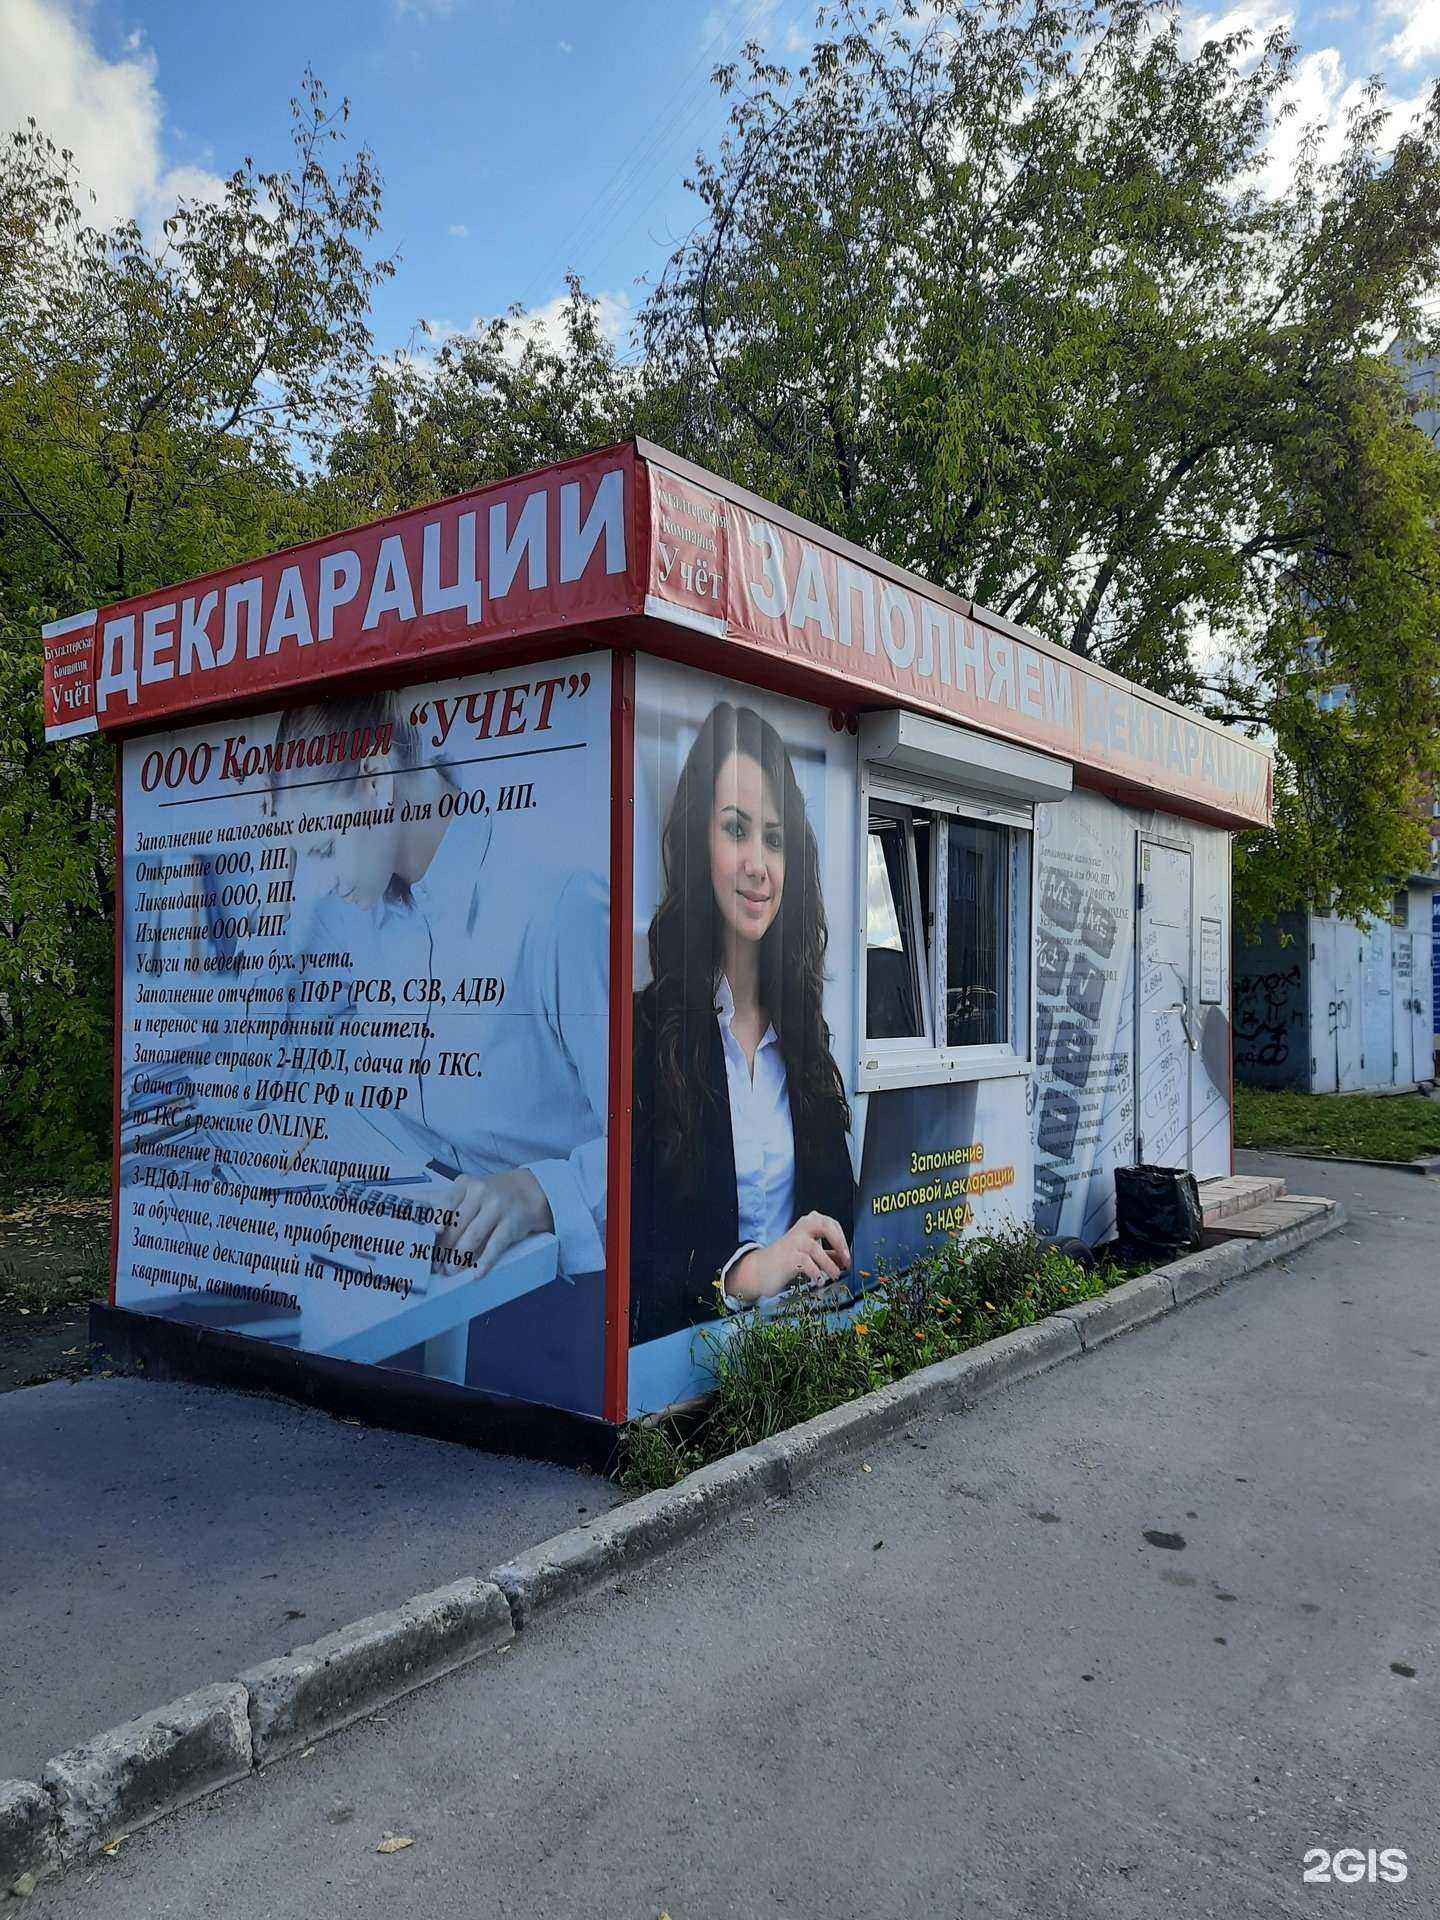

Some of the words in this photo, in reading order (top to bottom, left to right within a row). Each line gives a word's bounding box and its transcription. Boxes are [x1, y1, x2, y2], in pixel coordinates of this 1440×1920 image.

[656, 541, 723, 601] Учёт
[96, 469, 628, 714] ДЕКЛАРАЦИИ
[749, 521, 1075, 729] ЗАПОЛНЯЕМ
[50, 680, 92, 713] Учёт
[140, 740, 213, 793] ООО
[219, 721, 393, 783] Компания
[135, 828, 213, 852] Заполнение
[217, 820, 295, 842] налоговых
[298, 800, 395, 836] деклараций
[400, 800, 432, 823] для
[438, 788, 490, 818] ООО,
[496, 783, 538, 811] ИП.
[136, 860, 211, 885] Открытие
[215, 850, 255, 876] ООО,
[259, 847, 290, 871] ИП.
[135, 888, 217, 914] Ликвидация
[222, 883, 262, 908] ООО,
[266, 879, 296, 904] ИП.
[135, 920, 209, 943] Изменение
[213, 915, 253, 940] ООО,
[256, 914, 287, 937] ИП.
[136, 953, 180, 978] Услуги
[184, 957, 200, 973] по
[203, 952, 264, 974] ведению
[268, 949, 296, 975] бух.
[299, 951, 354, 975] учета.
[135, 983, 214, 1004] Заполнение
[217, 988, 284, 1004] отчетов
[287, 989, 297, 1003] в
[301, 979, 343, 1004] ПФР
[348, 979, 397, 1007] (РСВ,
[451, 977, 506, 1008] АДВ)
[134, 1018, 141, 1032] и
[145, 1018, 199, 1039] перенос
[202, 1020, 219, 1034] на
[223, 1015, 335, 1040] электронный
[339, 1020, 436, 1039] носитель.
[133, 1042, 210, 1067] Заполнение
[214, 1050, 272, 1073] справок
[276, 1047, 350, 1075] 2-НДФЛ,
[354, 1050, 403, 1075] сдача
[408, 1056, 432, 1076] по
[438, 1051, 483, 1078] ТКС.
[133, 1073, 173, 1096] Сдача
[176, 1082, 239, 1100] отчетов
[243, 1086, 251, 1100] в
[254, 1079, 310, 1104] ИФНС
[314, 1081, 340, 1107] РФ
[344, 1090, 355, 1107] и
[359, 1085, 409, 1110] ПФР
[132, 1109, 148, 1125] по
[152, 1105, 179, 1128] ТКС
[184, 1113, 191, 1128] в
[194, 1115, 254, 1135] режиме
[257, 1112, 329, 1141] ONLINE.
[133, 1134, 210, 1162] Заполнение
[214, 1147, 289, 1171] налоговой
[293, 1150, 391, 1184] декларации
[910, 1144, 984, 1174] Заполнение
[132, 1164, 191, 1191] 3-НДФЛ
[193, 1178, 210, 1194] по
[213, 1179, 281, 1208] возврату
[284, 1187, 386, 1218] подоходного
[391, 1201, 461, 1228] налога:
[872, 1178, 942, 1214] налоговой
[943, 1165, 1015, 1199] декларации
[132, 1200, 145, 1217] за
[148, 1199, 213, 1231] обучение,
[216, 1213, 280, 1241] лечение,
[284, 1223, 405, 1258] приобретение
[409, 1241, 478, 1269] жилья.
[924, 1201, 974, 1234] 3-НДФЛ
[132, 1226, 210, 1259] Заполнение
[213, 1240, 301, 1277] деклараций
[304, 1262, 325, 1280] на
[334, 1264, 414, 1300] продажу
[131, 1263, 202, 1296] квартиры,
[206, 1276, 302, 1311] автомобиля.
